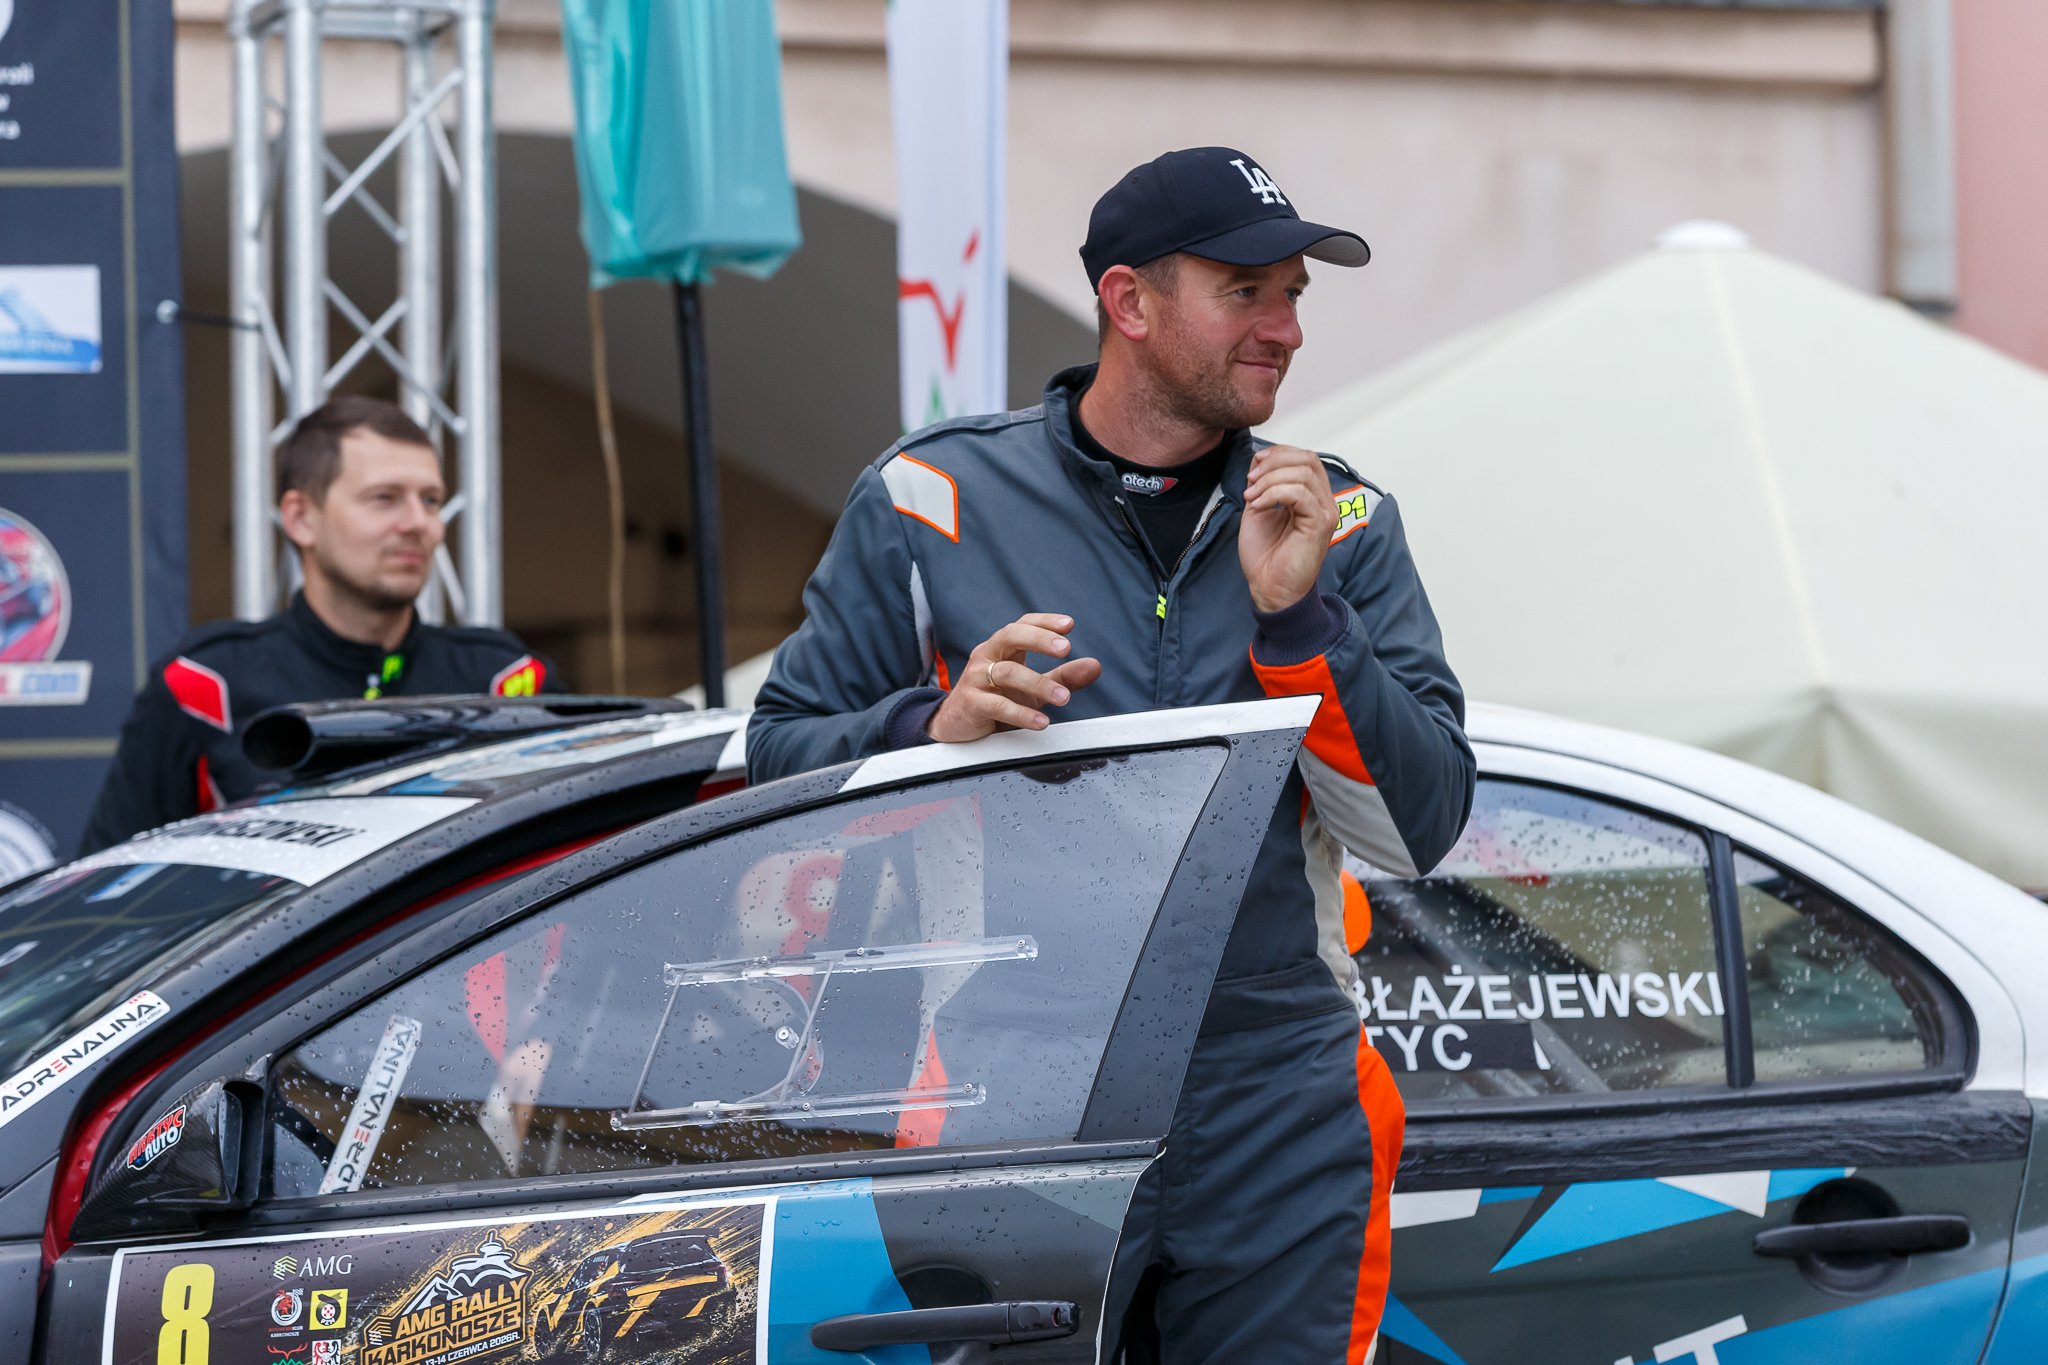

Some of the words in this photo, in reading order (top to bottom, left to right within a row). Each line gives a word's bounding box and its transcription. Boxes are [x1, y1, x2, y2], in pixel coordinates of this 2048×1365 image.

[1229, 159, 1287, 205] LA
[1354, 964, 1725, 1020] BŁAŻEJEWSKI
[144, 1126, 178, 1161] AUTO
[299, 1254, 353, 1278] AMG
[157, 1263, 214, 1365] 8
[396, 1303, 446, 1340] AMG
[451, 1276, 528, 1321] RALLY
[367, 1307, 521, 1365] KARKONOSZE
[447, 1342, 489, 1362] CZERWCA
